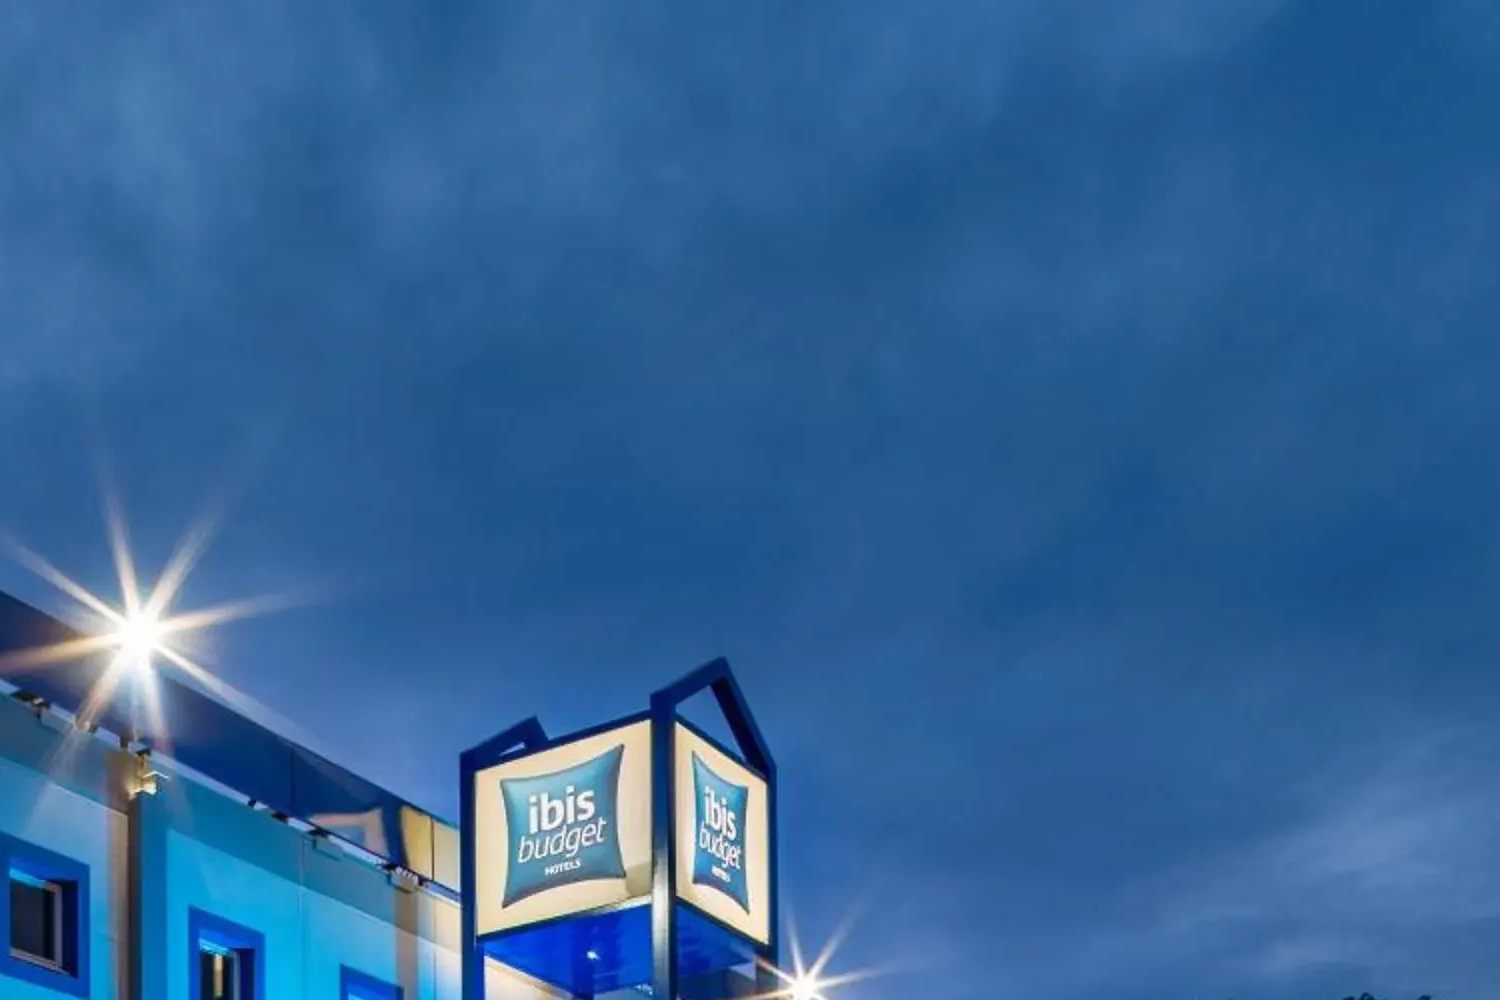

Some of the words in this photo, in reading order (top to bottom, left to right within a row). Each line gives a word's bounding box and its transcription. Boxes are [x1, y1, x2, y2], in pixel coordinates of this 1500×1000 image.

[528, 785, 596, 835] ibis
[704, 785, 737, 841] ibis
[517, 816, 607, 863] budget
[700, 819, 742, 870] budget
